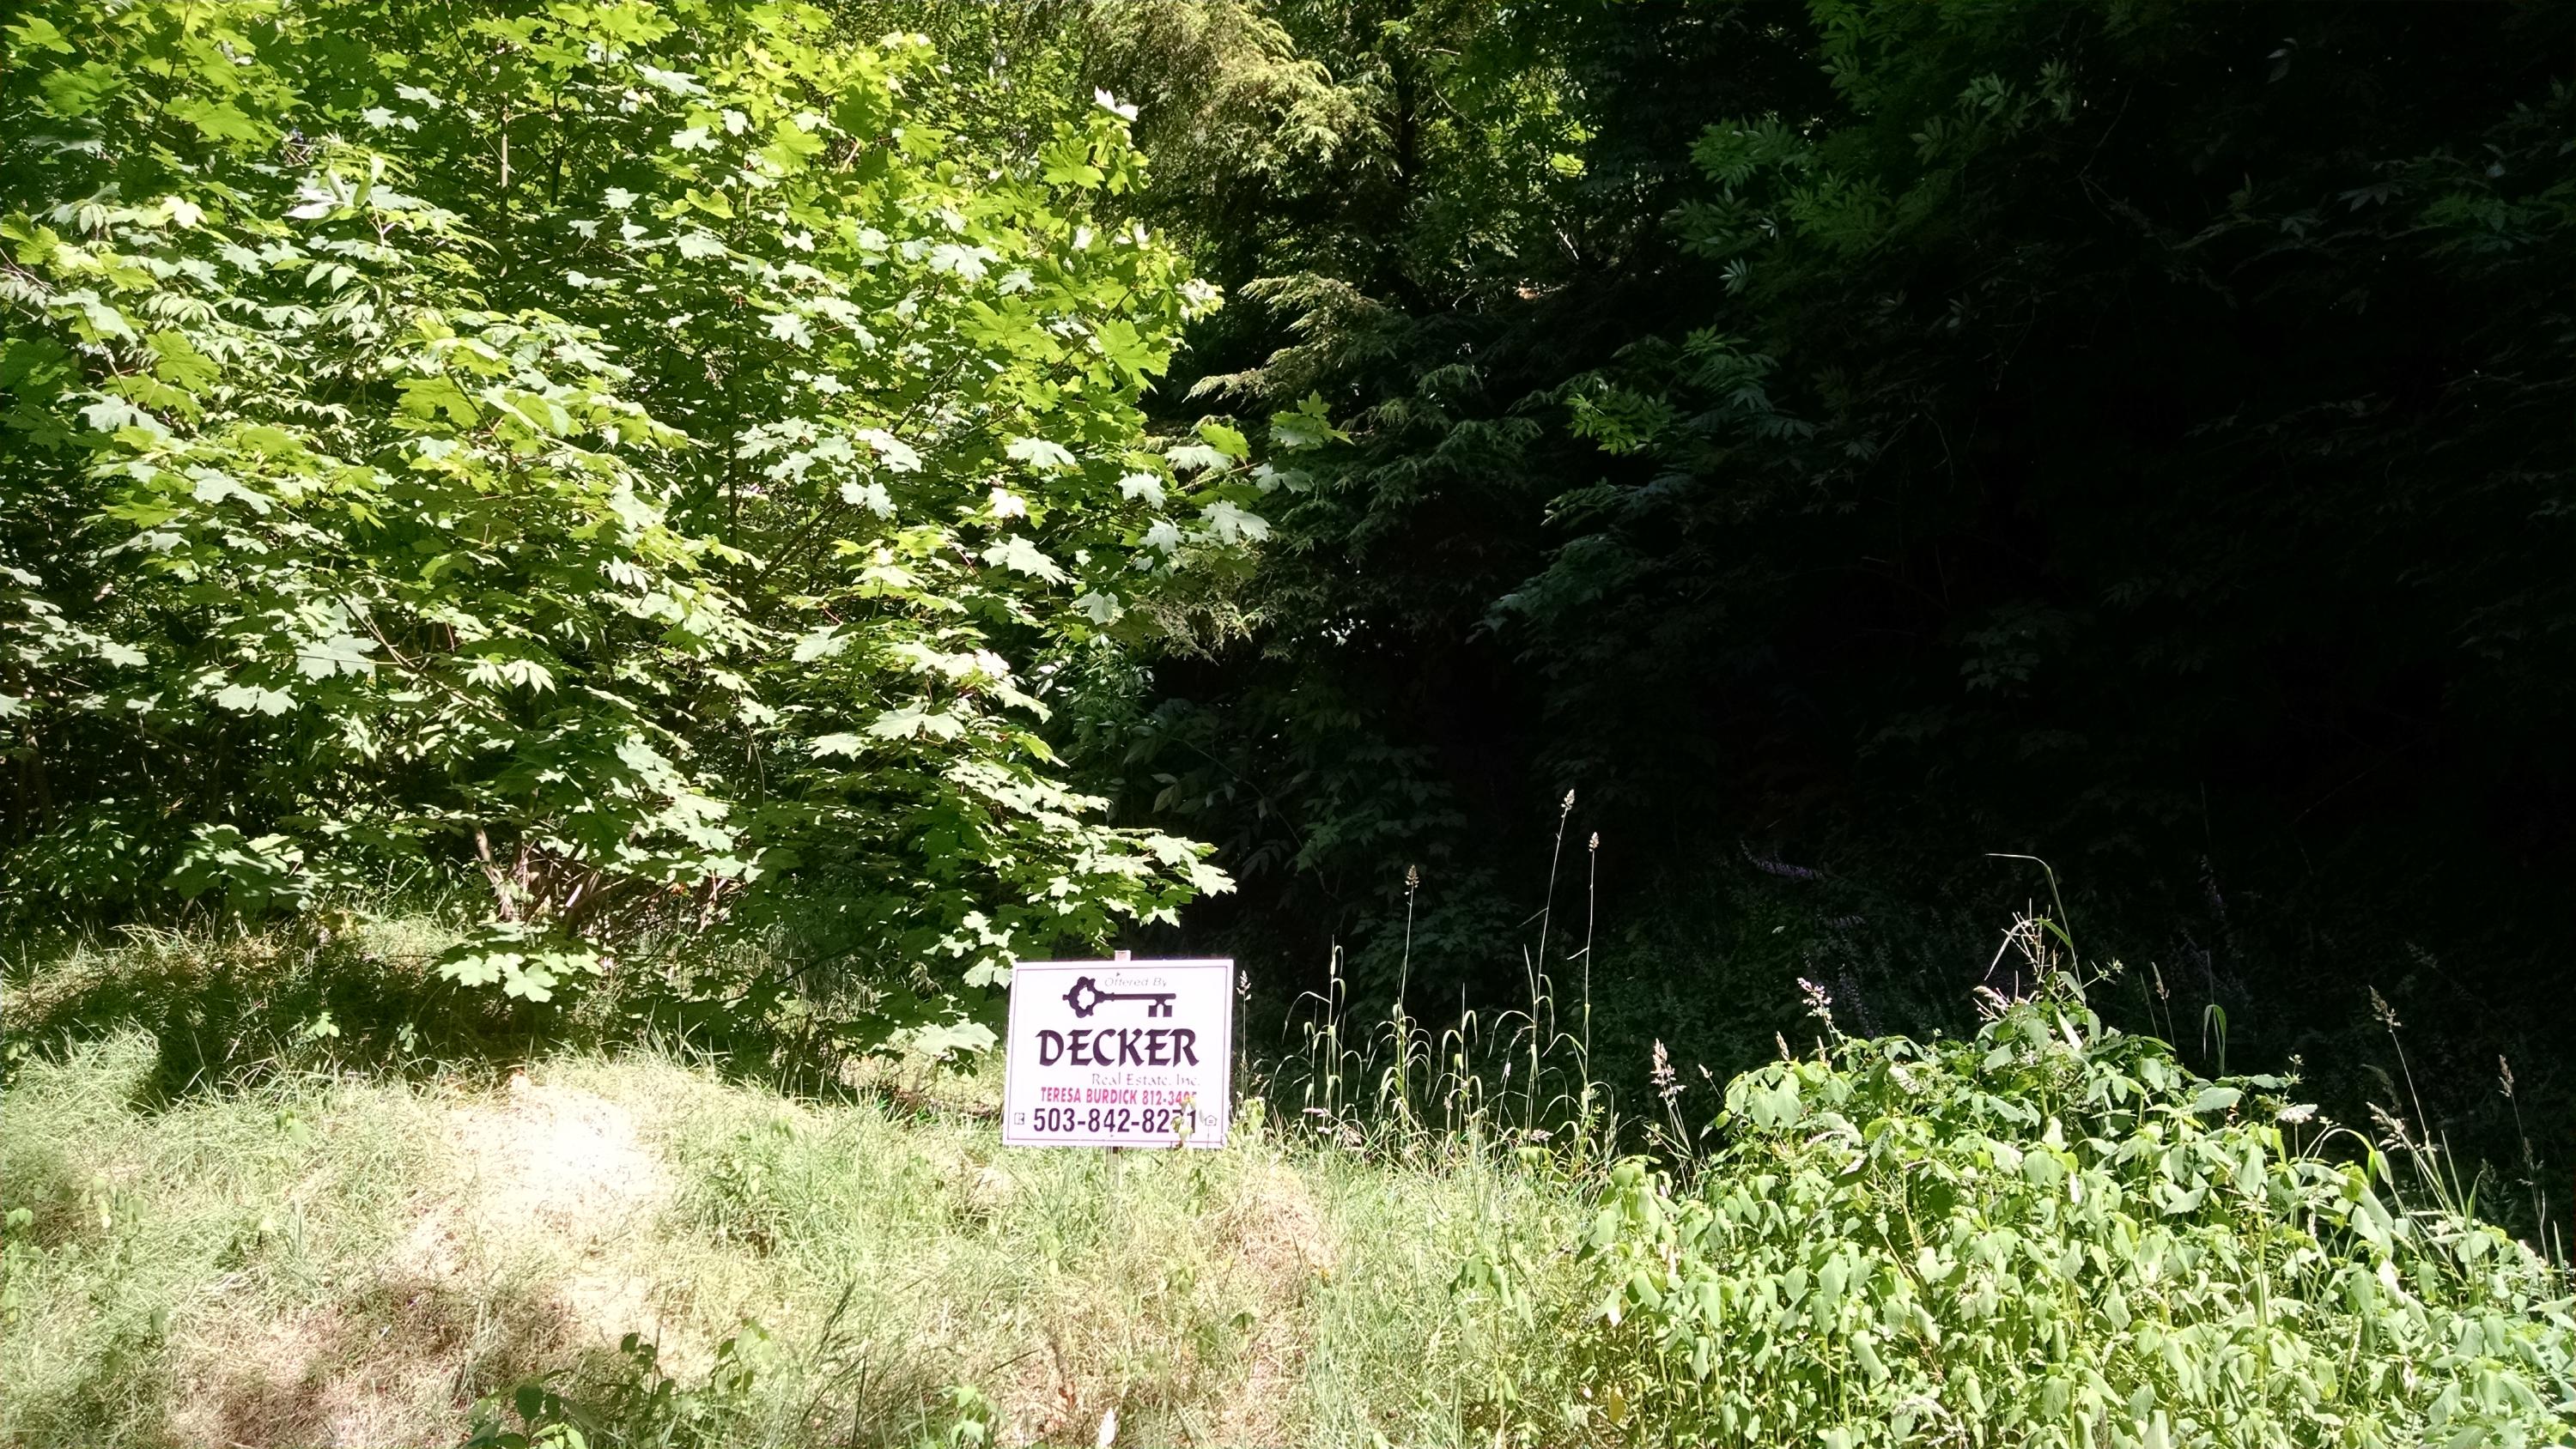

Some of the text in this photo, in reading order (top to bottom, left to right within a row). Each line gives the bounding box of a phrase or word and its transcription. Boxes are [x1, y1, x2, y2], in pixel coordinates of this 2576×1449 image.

[1104, 977, 1167, 988] Offered By
[1035, 1028, 1200, 1067] DECKER
[1091, 1071, 1121, 1086] Real
[1041, 1087, 1081, 1103] TERESA
[1086, 1088, 1138, 1105] BURDICK
